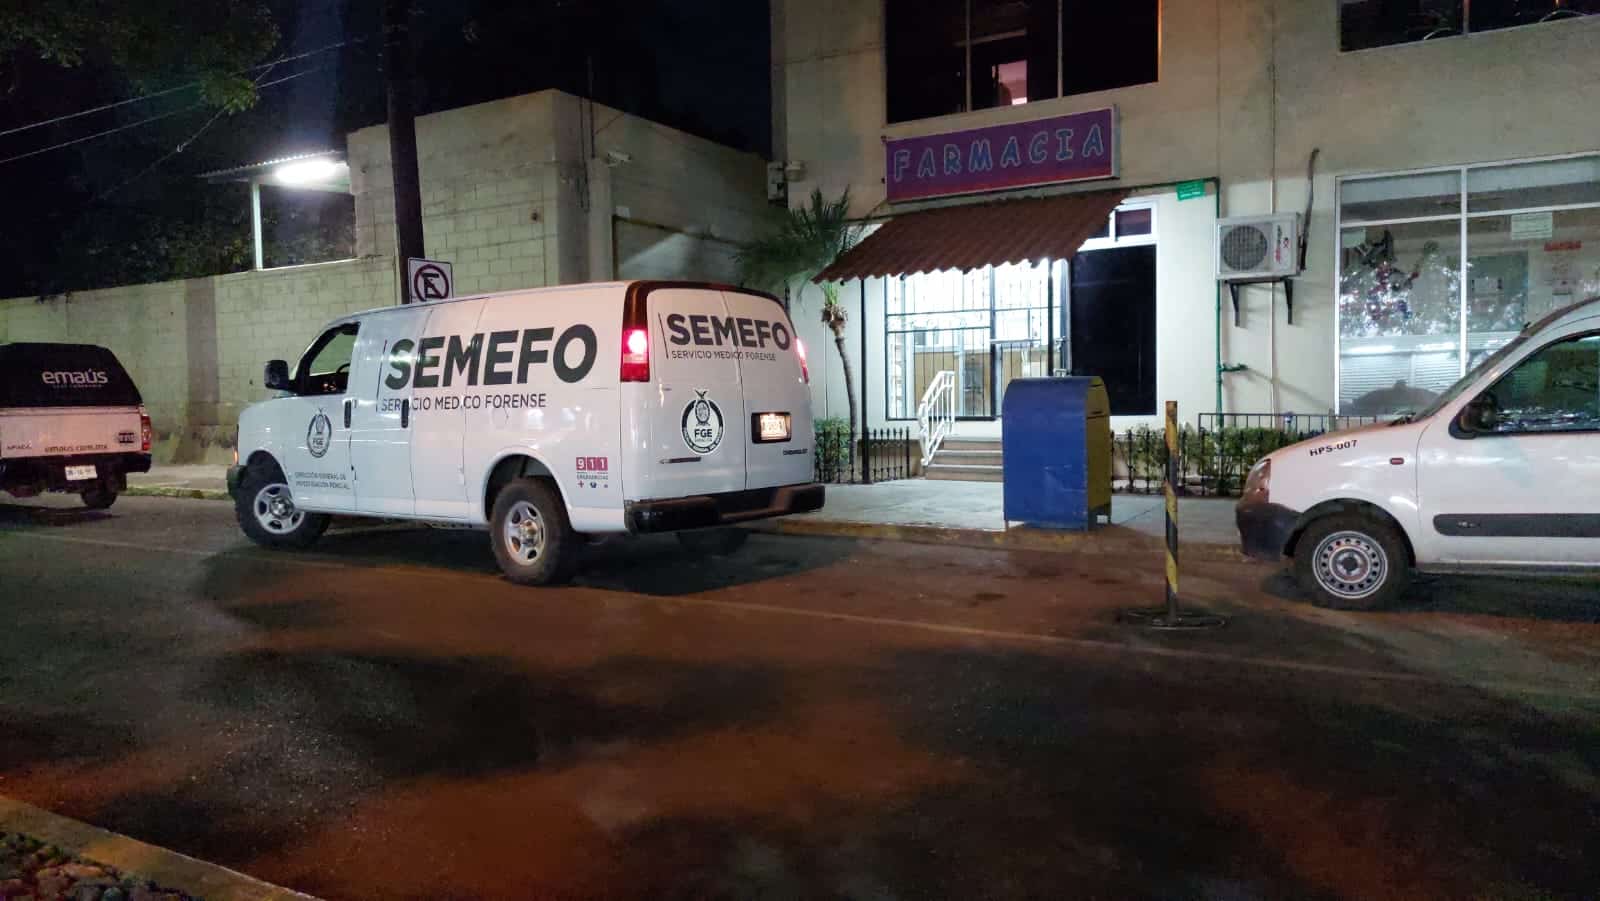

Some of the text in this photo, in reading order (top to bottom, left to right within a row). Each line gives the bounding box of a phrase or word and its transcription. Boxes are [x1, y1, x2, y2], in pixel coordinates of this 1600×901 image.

[893, 123, 1104, 181] FARMACIA
[666, 313, 791, 350] SEMEFO
[384, 323, 598, 390] SEMEFO
[671, 350, 711, 359] SERVICIO
[42, 368, 108, 384] emaús
[381, 397, 431, 411] SERCIO
[484, 393, 547, 409] FORENSE
[694, 428, 712, 438] FGE
[1309, 440, 1358, 456] HPS-007
[578, 458, 606, 469] 911
